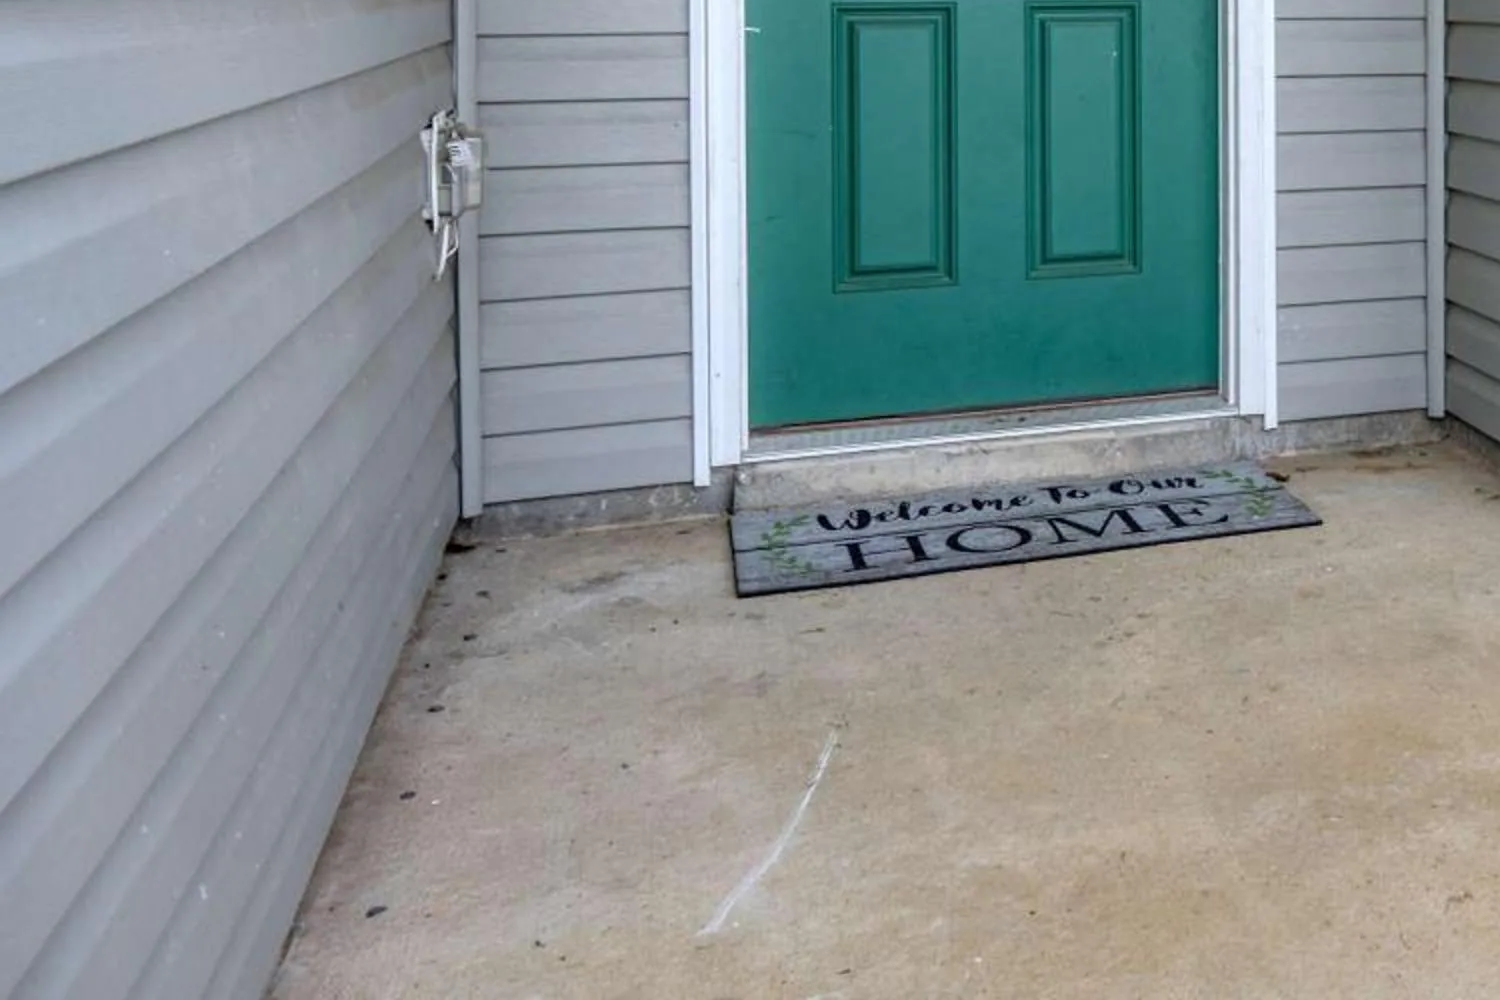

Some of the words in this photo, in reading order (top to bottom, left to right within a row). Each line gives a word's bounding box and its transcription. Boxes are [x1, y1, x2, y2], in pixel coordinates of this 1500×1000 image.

[816, 494, 1034, 531] Welcome
[1038, 484, 1091, 505] To
[1107, 476, 1203, 496] Our
[835, 498, 1229, 572] HOME
